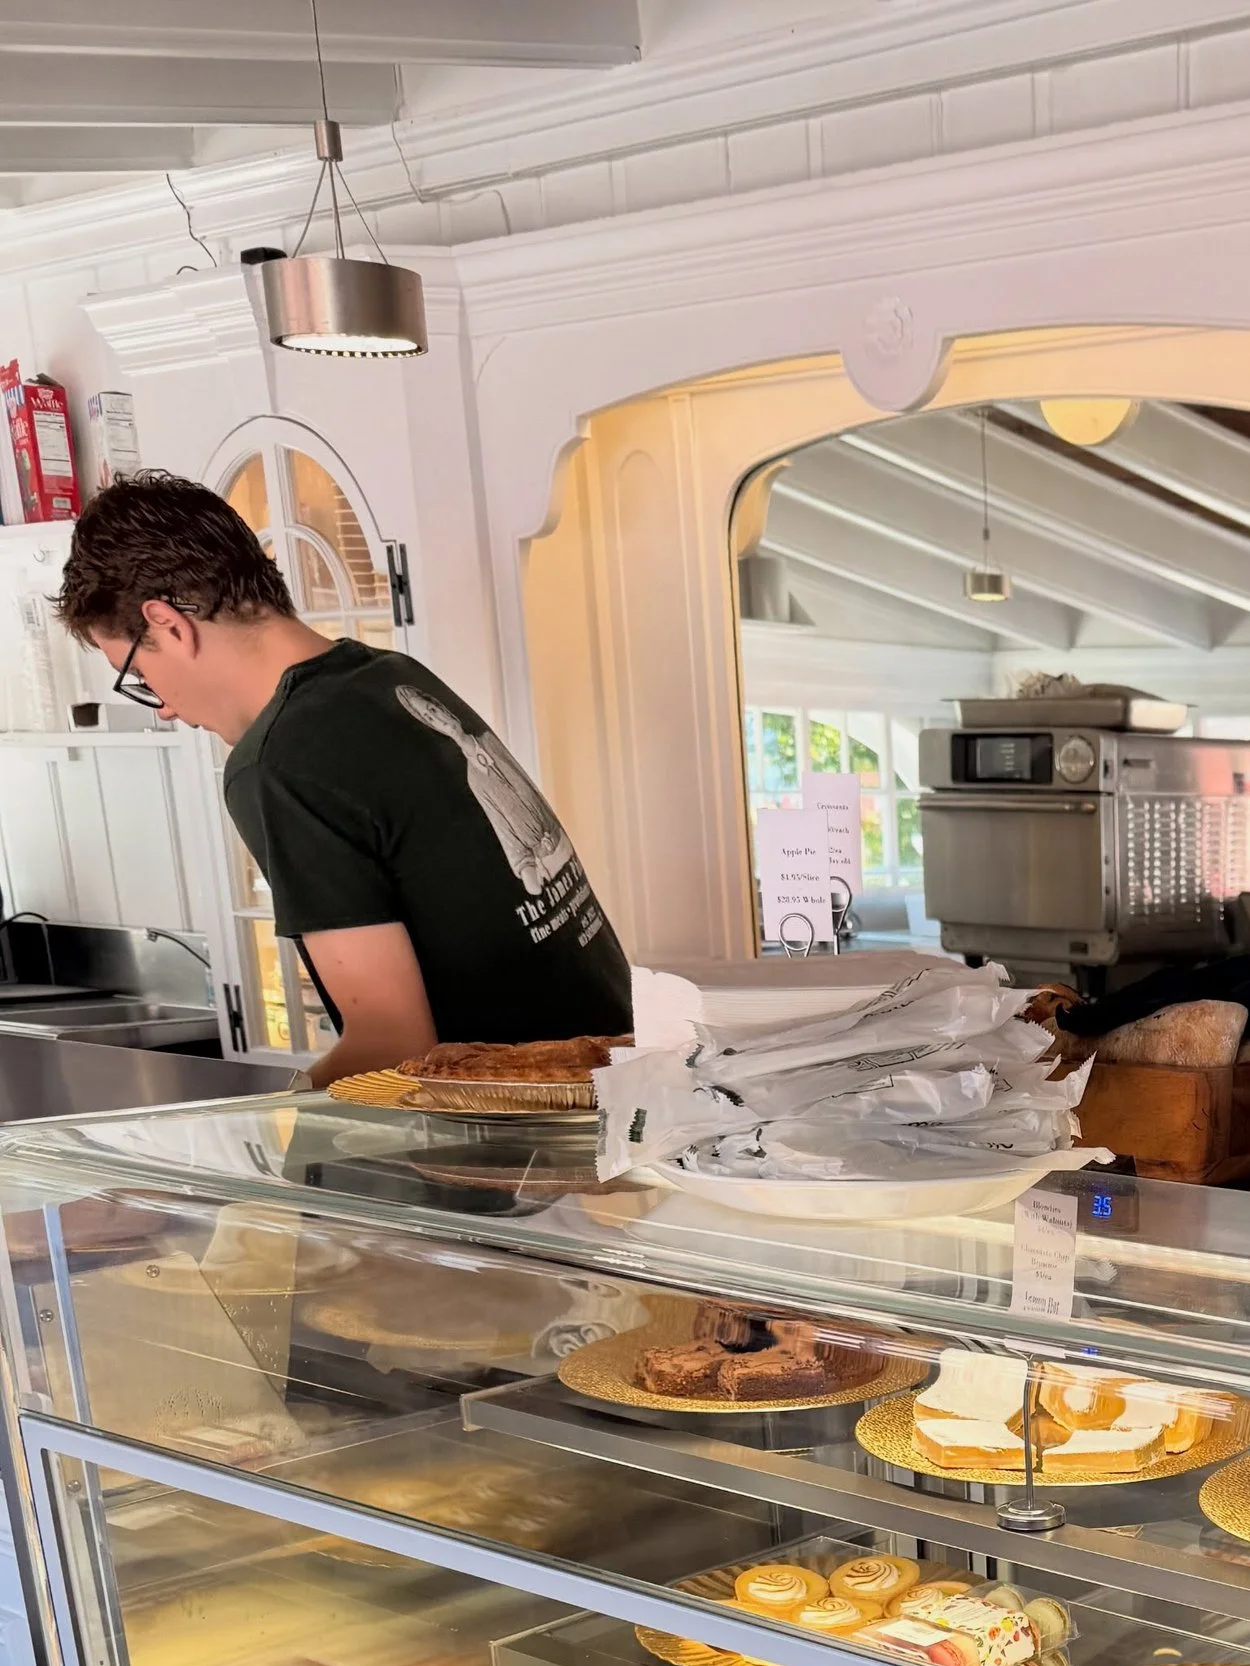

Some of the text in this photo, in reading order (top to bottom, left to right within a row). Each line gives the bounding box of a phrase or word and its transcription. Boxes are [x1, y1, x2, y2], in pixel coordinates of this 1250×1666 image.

[782, 848, 816, 858] Apple Pie
[515, 899, 547, 927] The
[1041, 1214, 1073, 1228] Walnuts)
